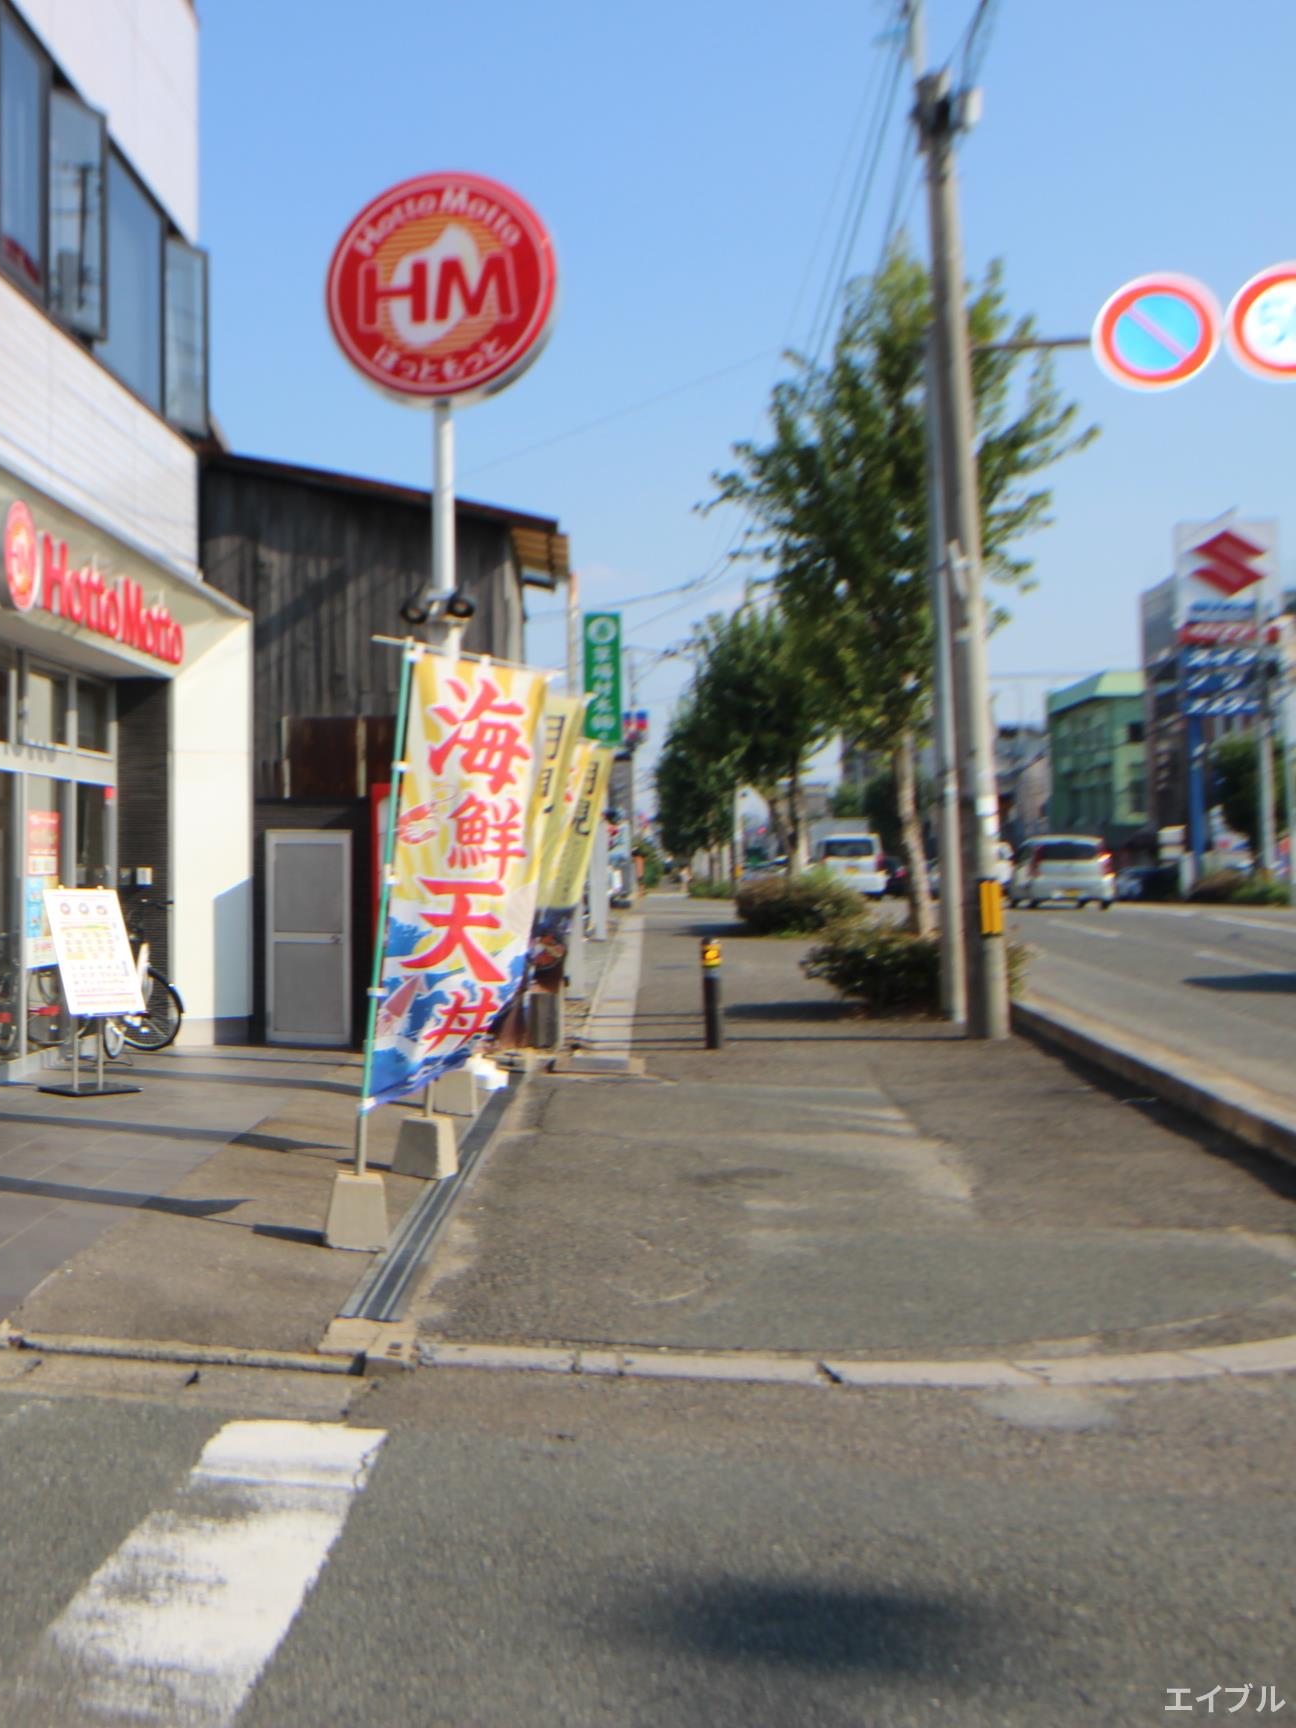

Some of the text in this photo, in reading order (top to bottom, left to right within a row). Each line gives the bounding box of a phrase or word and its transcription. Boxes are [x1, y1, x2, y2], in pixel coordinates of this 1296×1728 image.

[358, 251, 519, 333] HM
[403, 678, 531, 1054] 海鮮天丼
